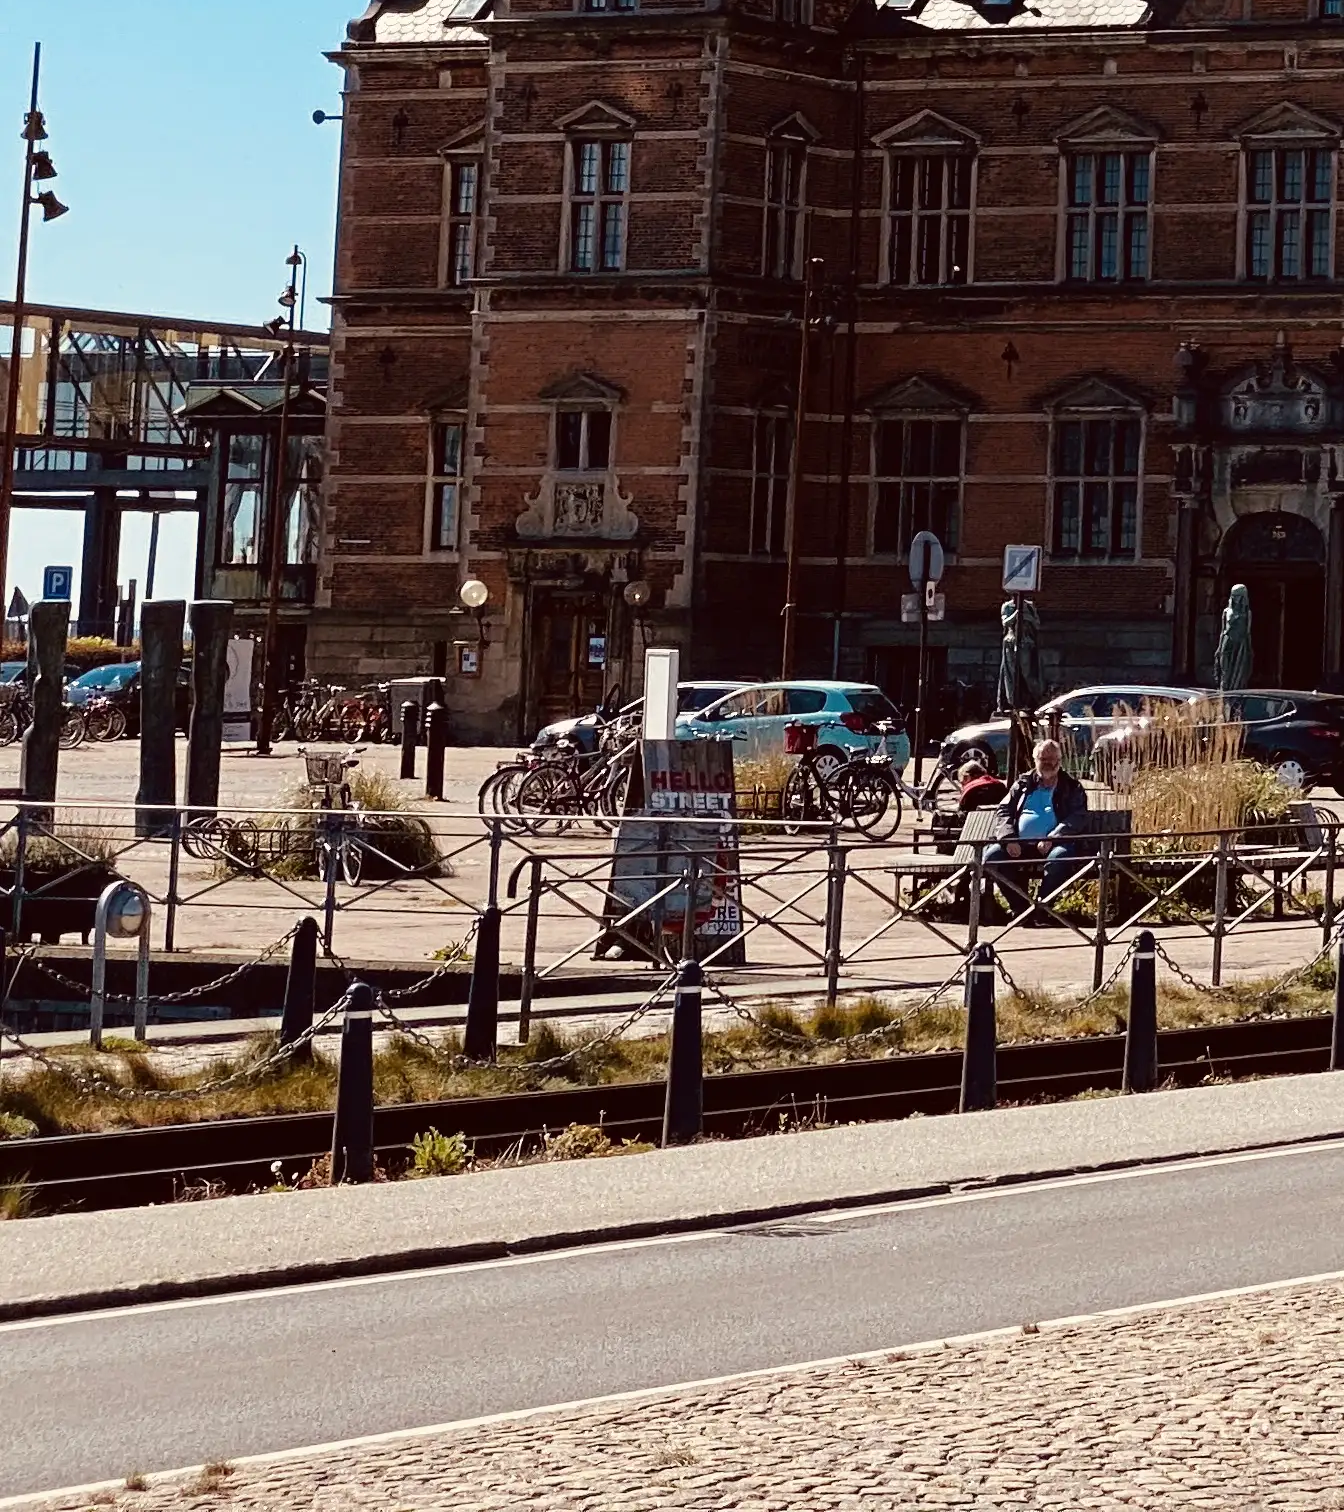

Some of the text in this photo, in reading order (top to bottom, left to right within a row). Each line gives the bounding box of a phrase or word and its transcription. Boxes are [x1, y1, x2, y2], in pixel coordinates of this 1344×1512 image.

[51, 572, 65, 593] P
[651, 771, 731, 791] HELLO
[651, 792, 732, 809] STREET
